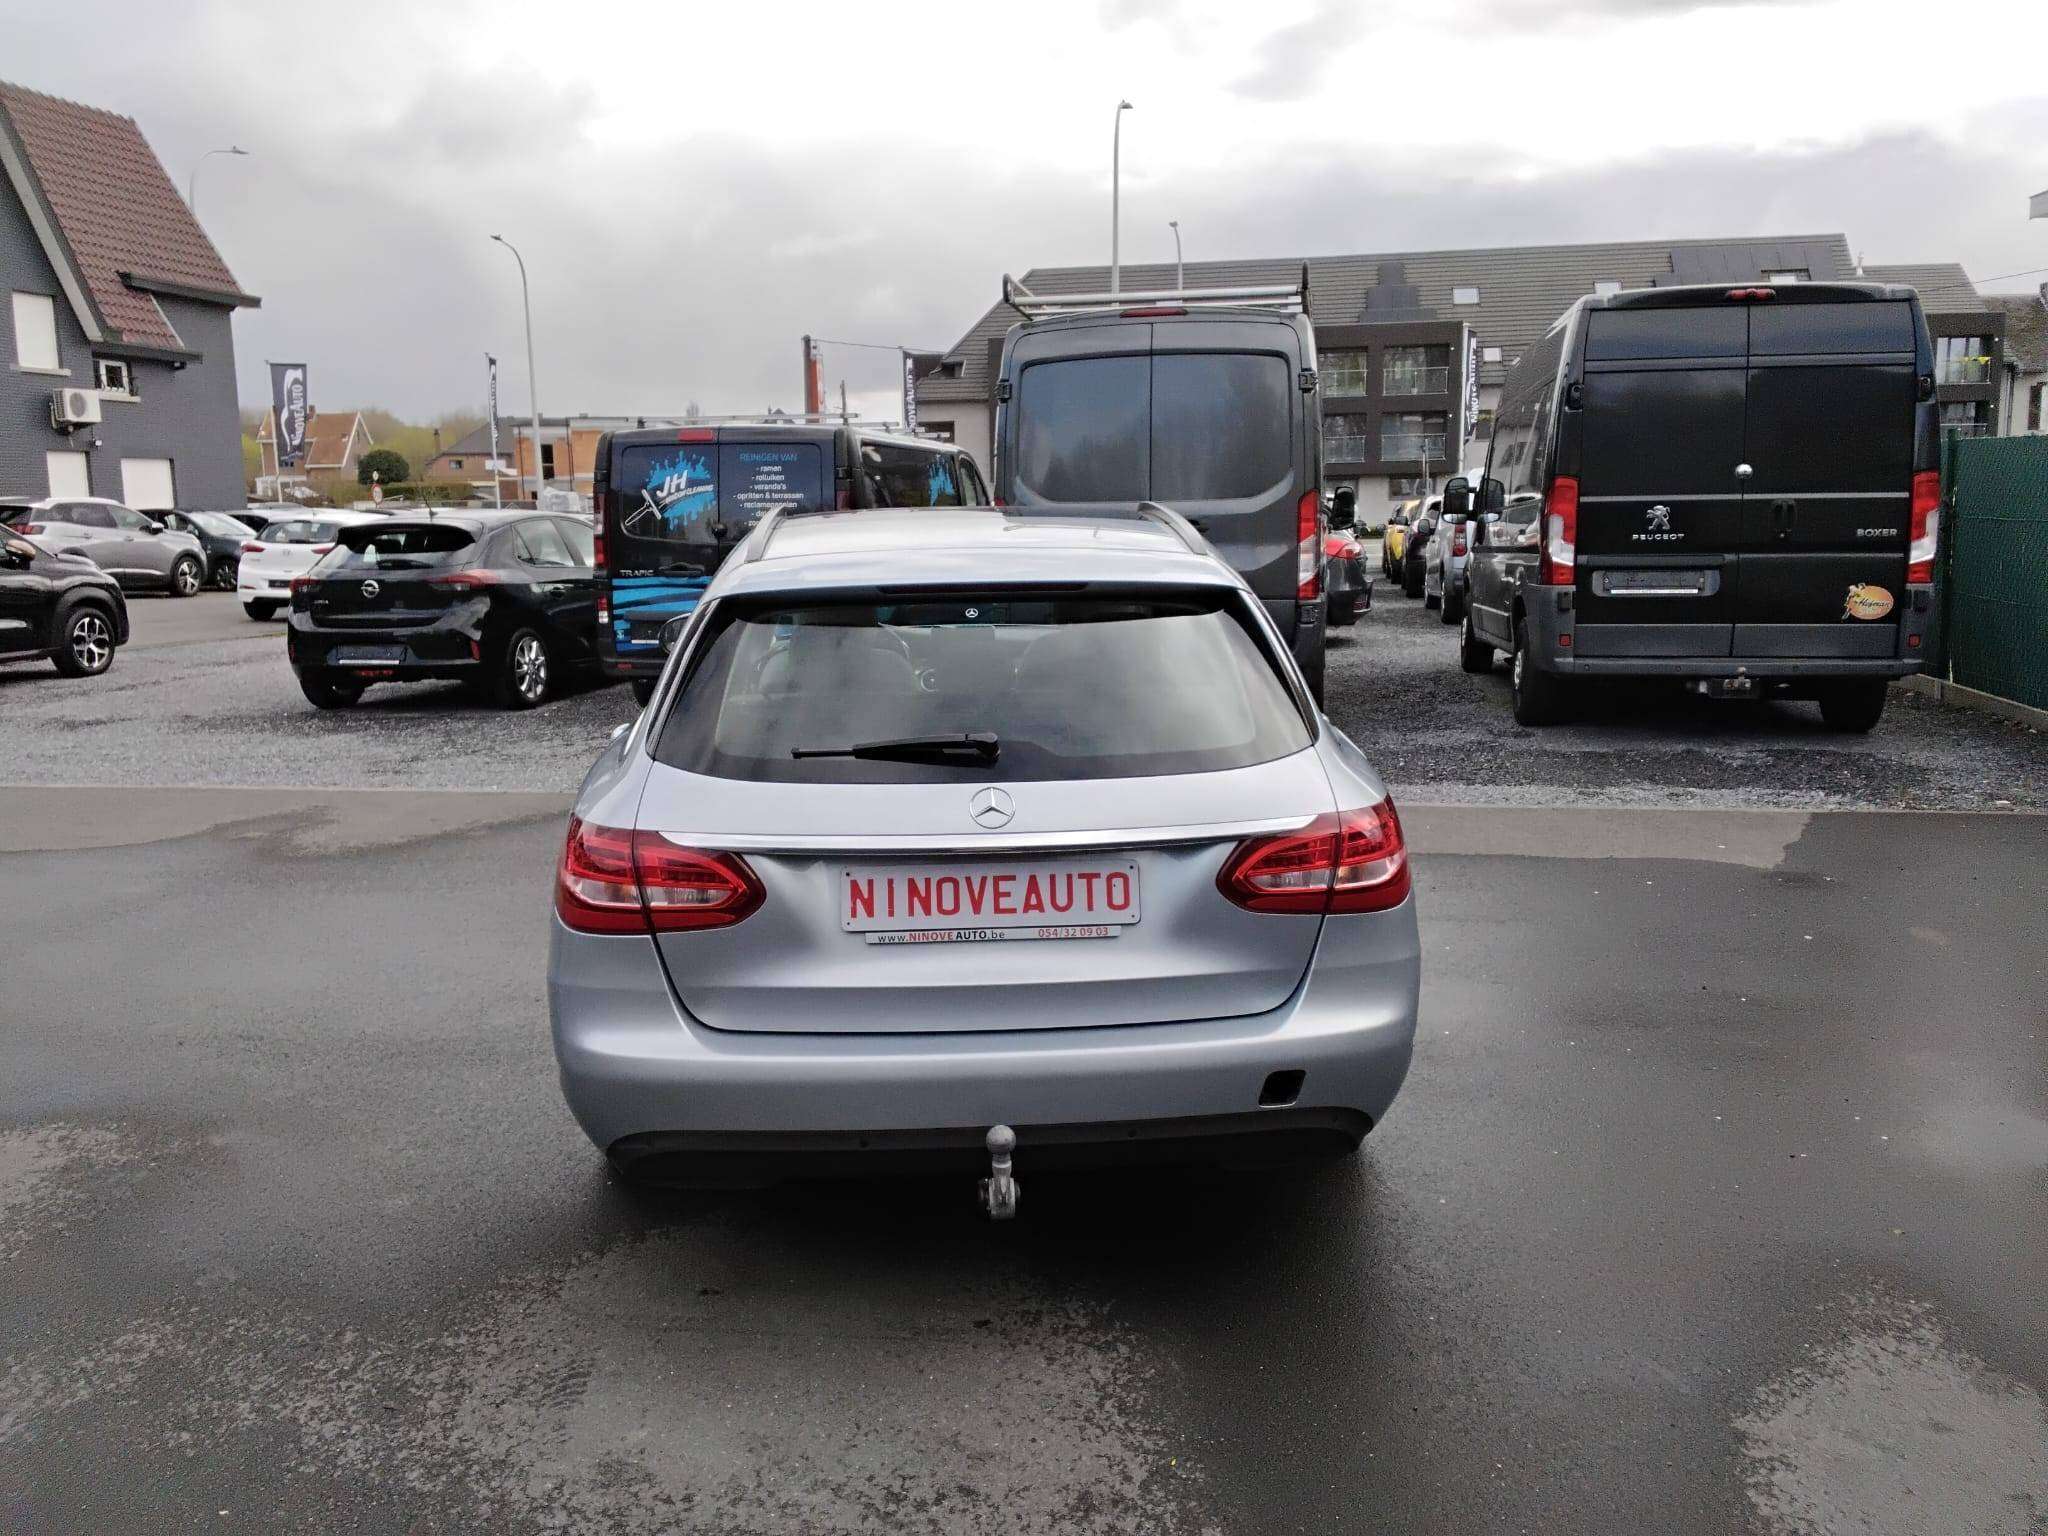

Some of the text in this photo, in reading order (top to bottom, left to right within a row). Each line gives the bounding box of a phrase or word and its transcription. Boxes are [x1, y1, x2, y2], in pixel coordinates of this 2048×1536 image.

[739, 452, 798, 462] REINIGEN VAN
[656, 469, 688, 498] JH
[753, 482, 787, 490] veranda's
[737, 491, 764, 500] opritten
[771, 491, 804, 499] terrassen
[1856, 528, 1898, 537] BOXER
[850, 871, 1131, 919] NINOVEAUTO
[877, 927, 1109, 943] www.NINOVEAUTO.be 054/32 09 03
